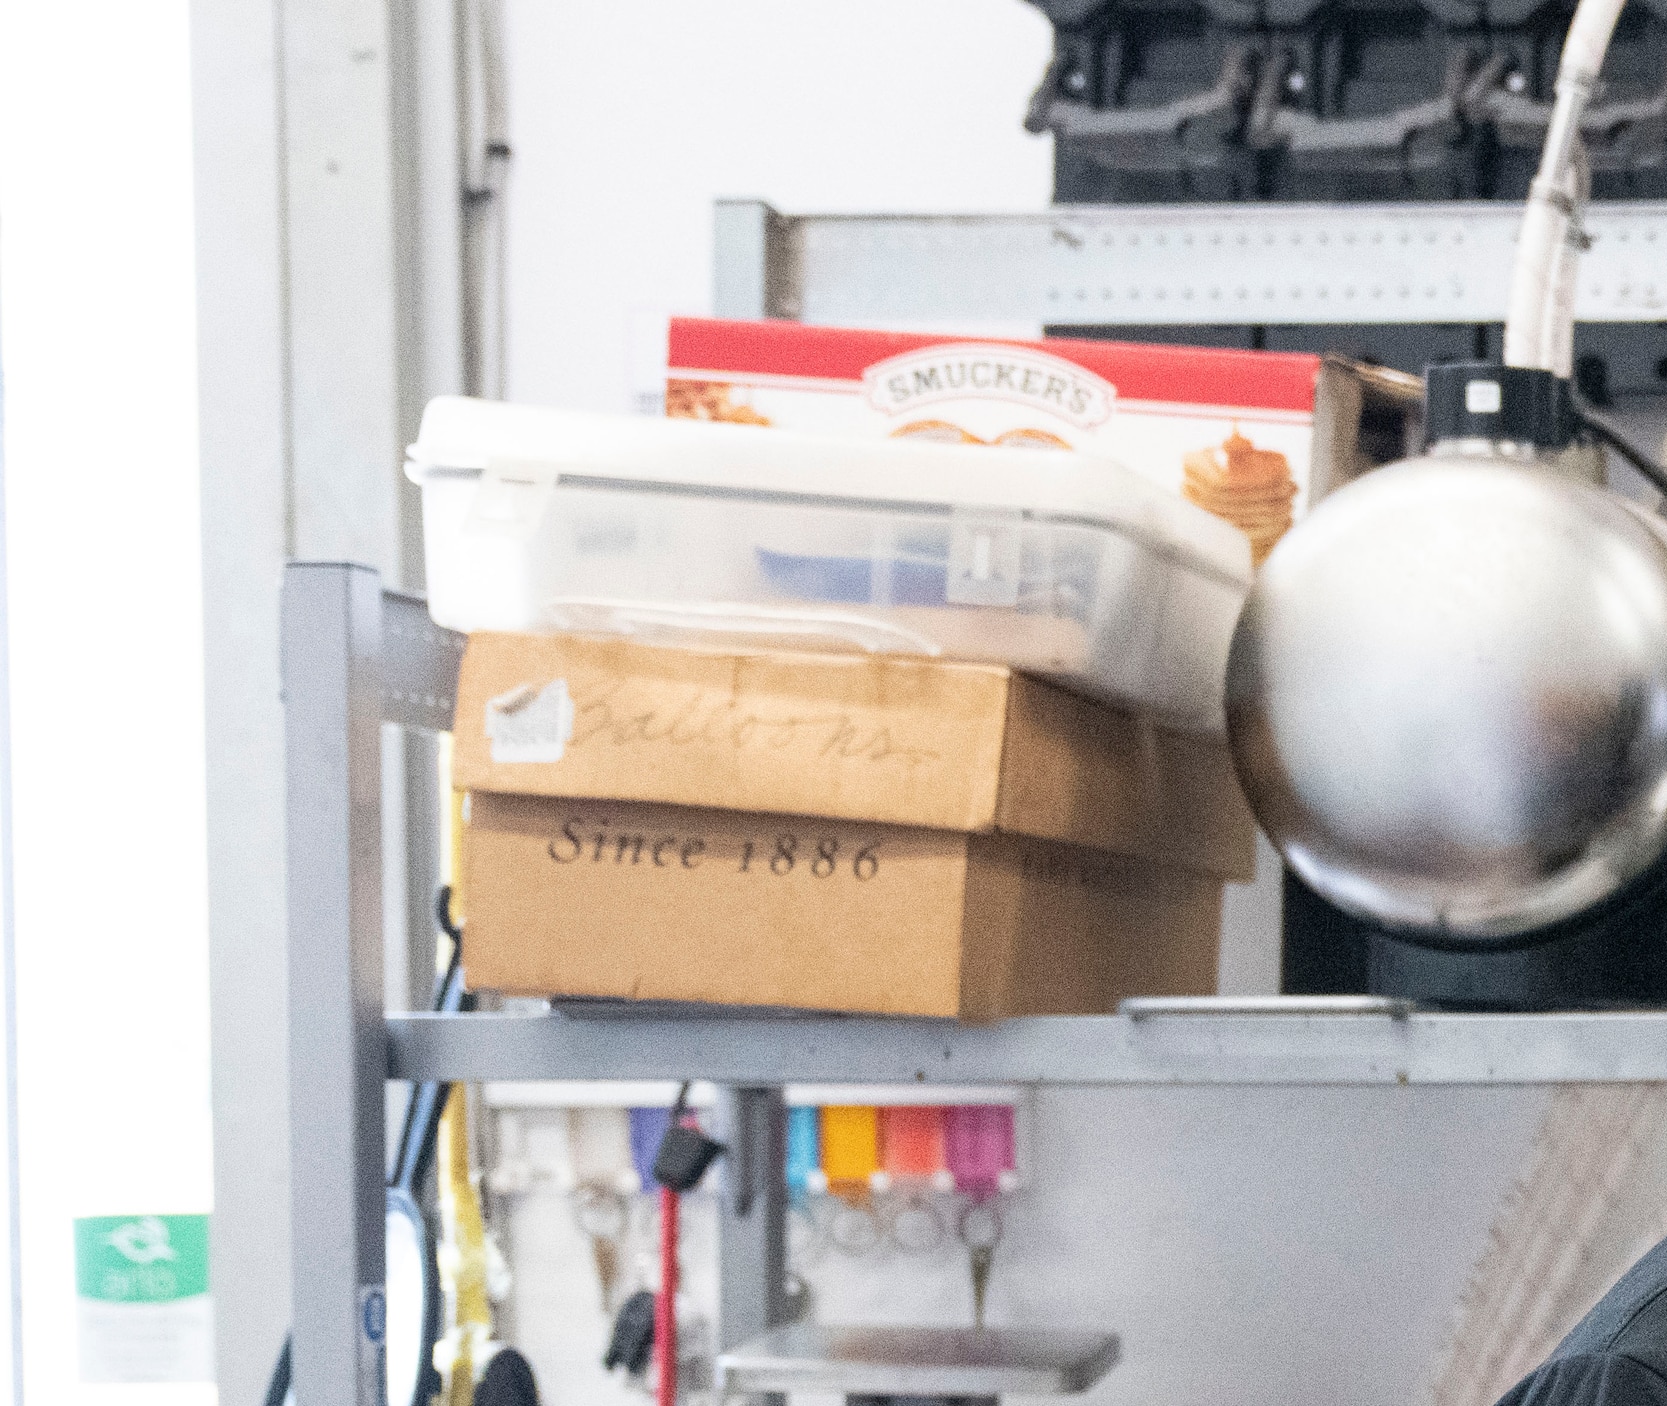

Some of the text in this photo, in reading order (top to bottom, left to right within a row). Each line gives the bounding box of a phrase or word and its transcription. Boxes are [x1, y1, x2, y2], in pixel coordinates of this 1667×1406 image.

[887, 361, 1092, 414] SMUCKER'S
[548, 816, 880, 882] Since 1886
